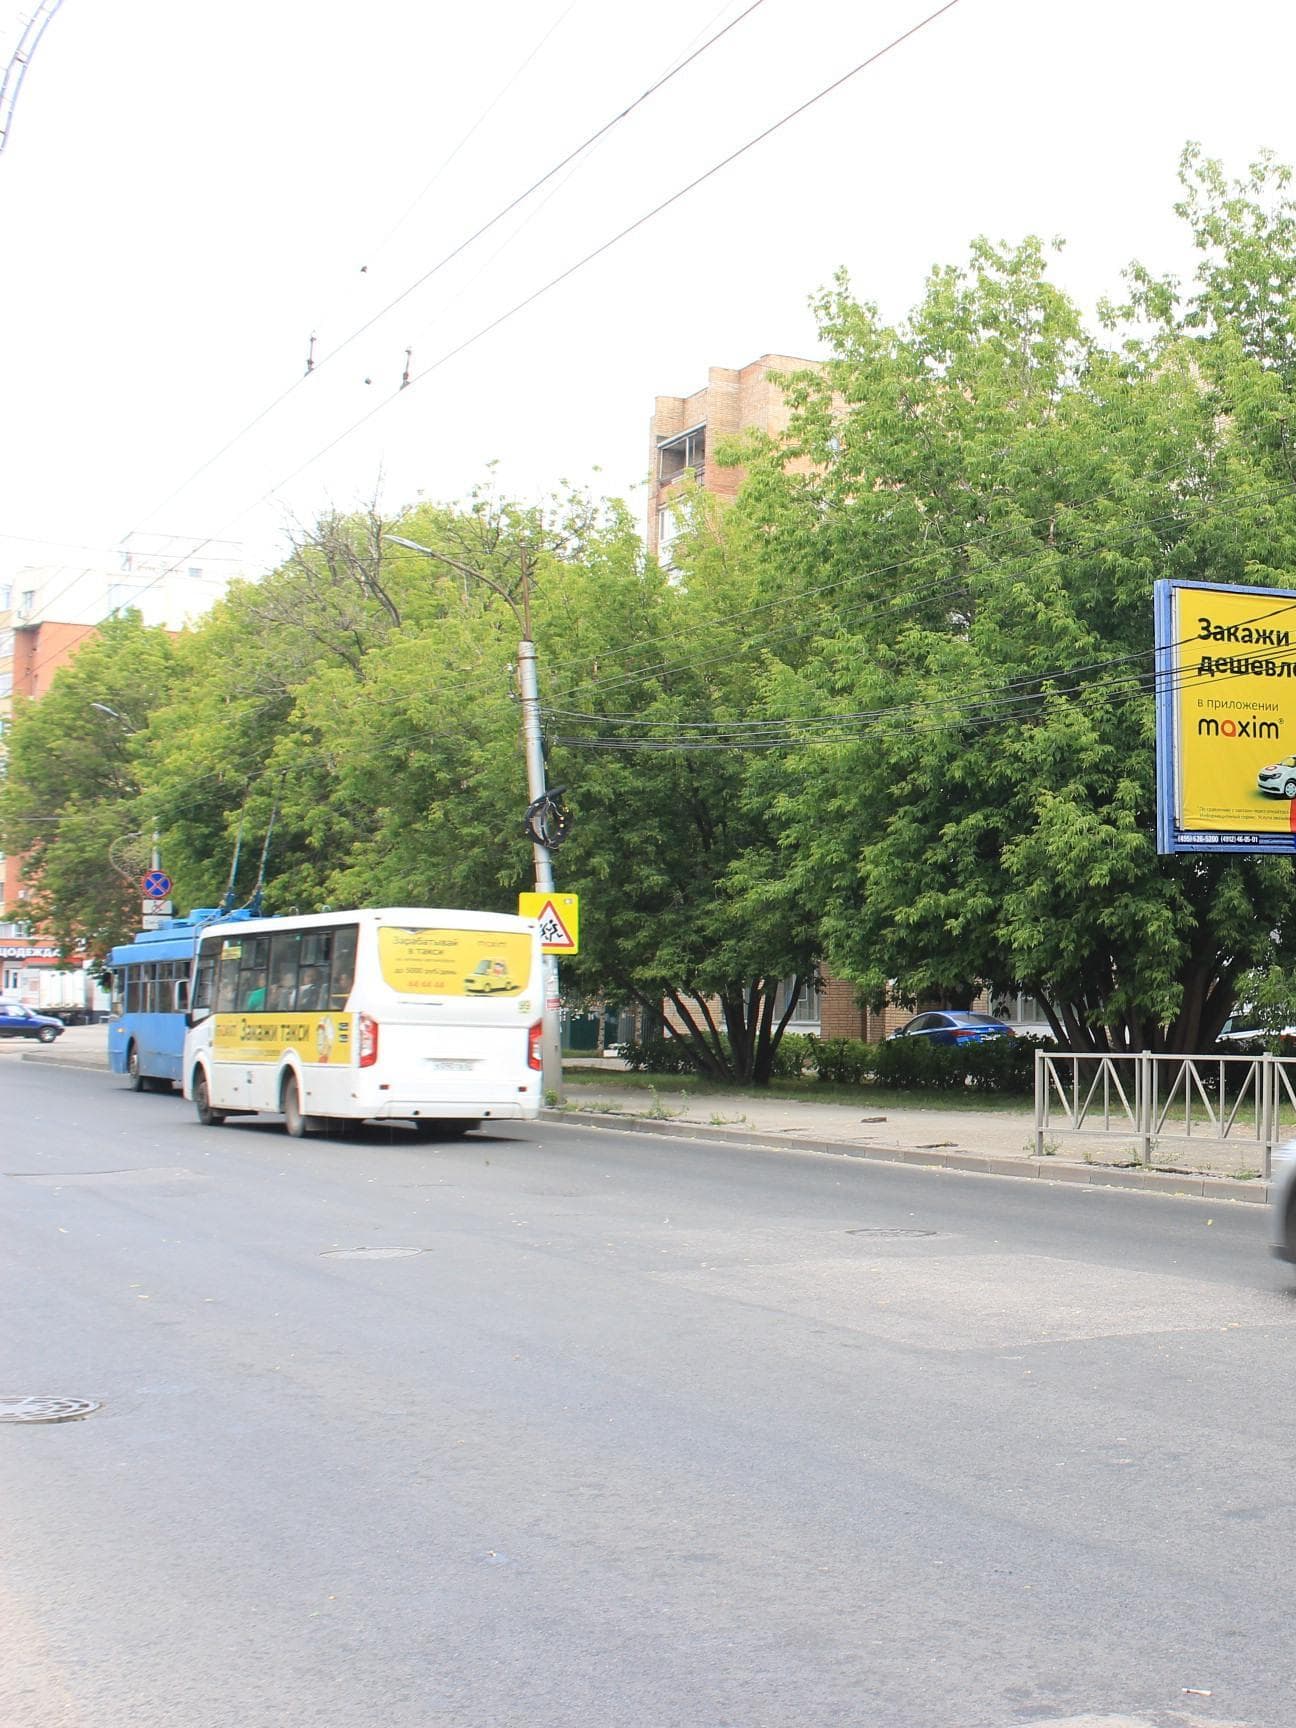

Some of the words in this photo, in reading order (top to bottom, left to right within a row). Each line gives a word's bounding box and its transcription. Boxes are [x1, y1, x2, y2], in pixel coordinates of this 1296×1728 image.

[1197, 615, 1290, 647] Закажи
[1197, 698, 1204, 708] в
[1206, 699, 1280, 712] приложении
[1198, 715, 1280, 740] maxim
[415, 948, 444, 956] такси
[238, 1017, 278, 1042] Закажи
[280, 1023, 310, 1042] такси
